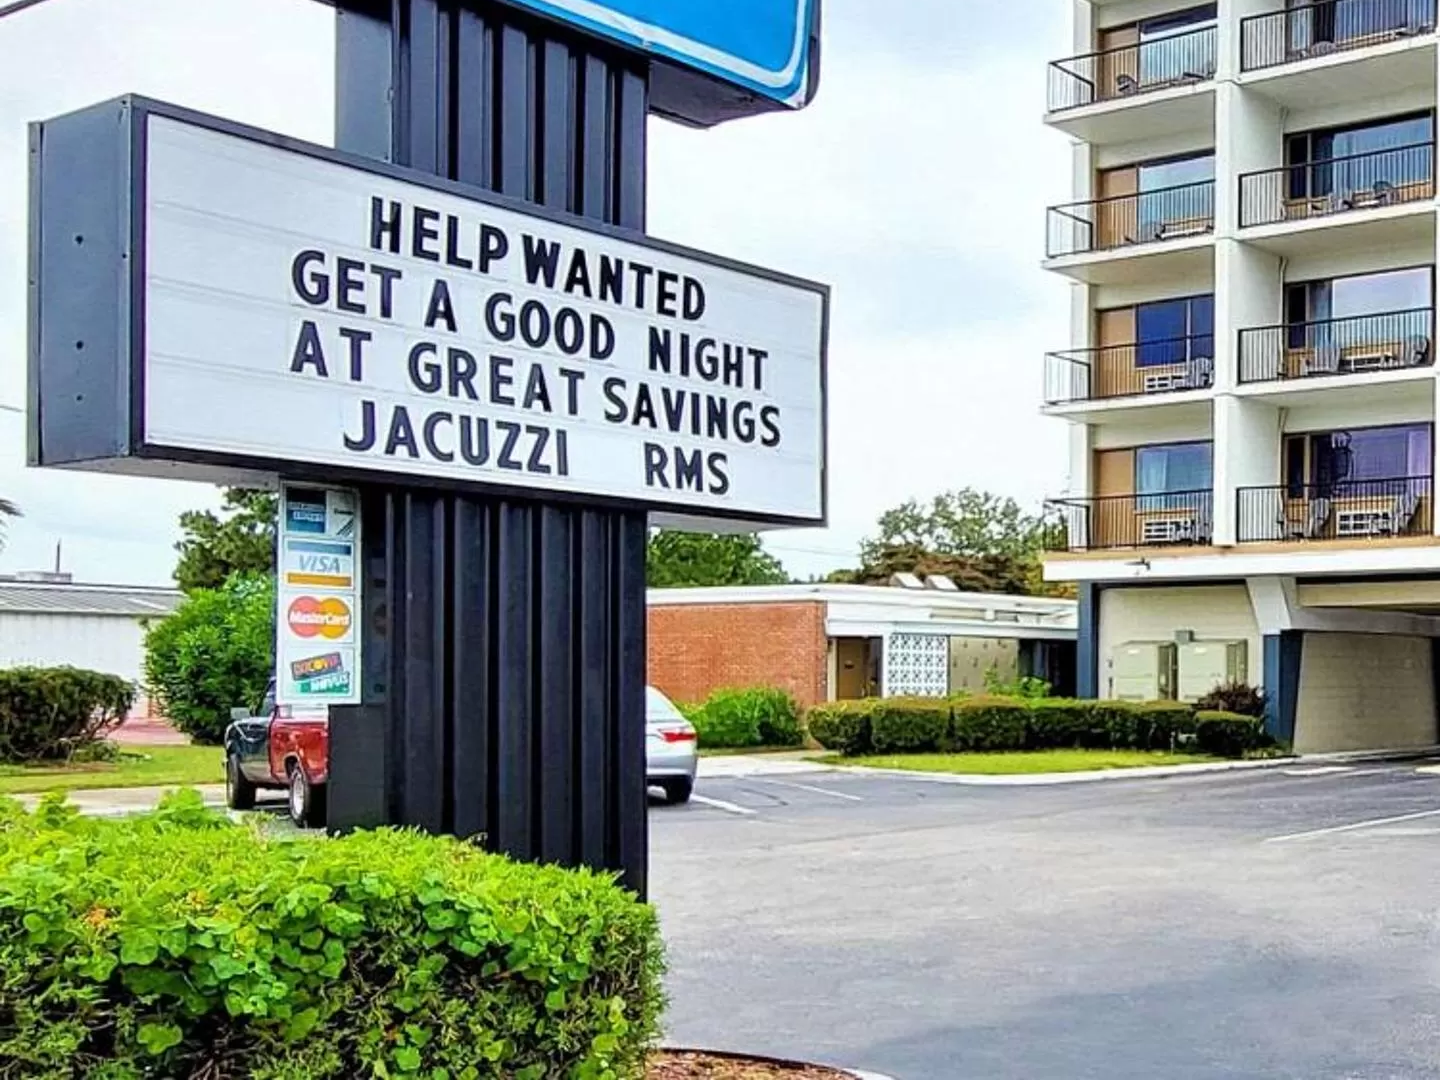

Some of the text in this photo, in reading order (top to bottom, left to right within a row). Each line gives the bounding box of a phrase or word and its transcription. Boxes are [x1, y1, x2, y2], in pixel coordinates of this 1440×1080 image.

[292, 250, 768, 390] GET A GOOD NIGHT
[371, 196, 706, 321] HELP WANTED
[290, 320, 781, 447] AT GREAT SAVINGS
[343, 400, 729, 495] JACUZZI RMS
[299, 555, 341, 573] VISA
